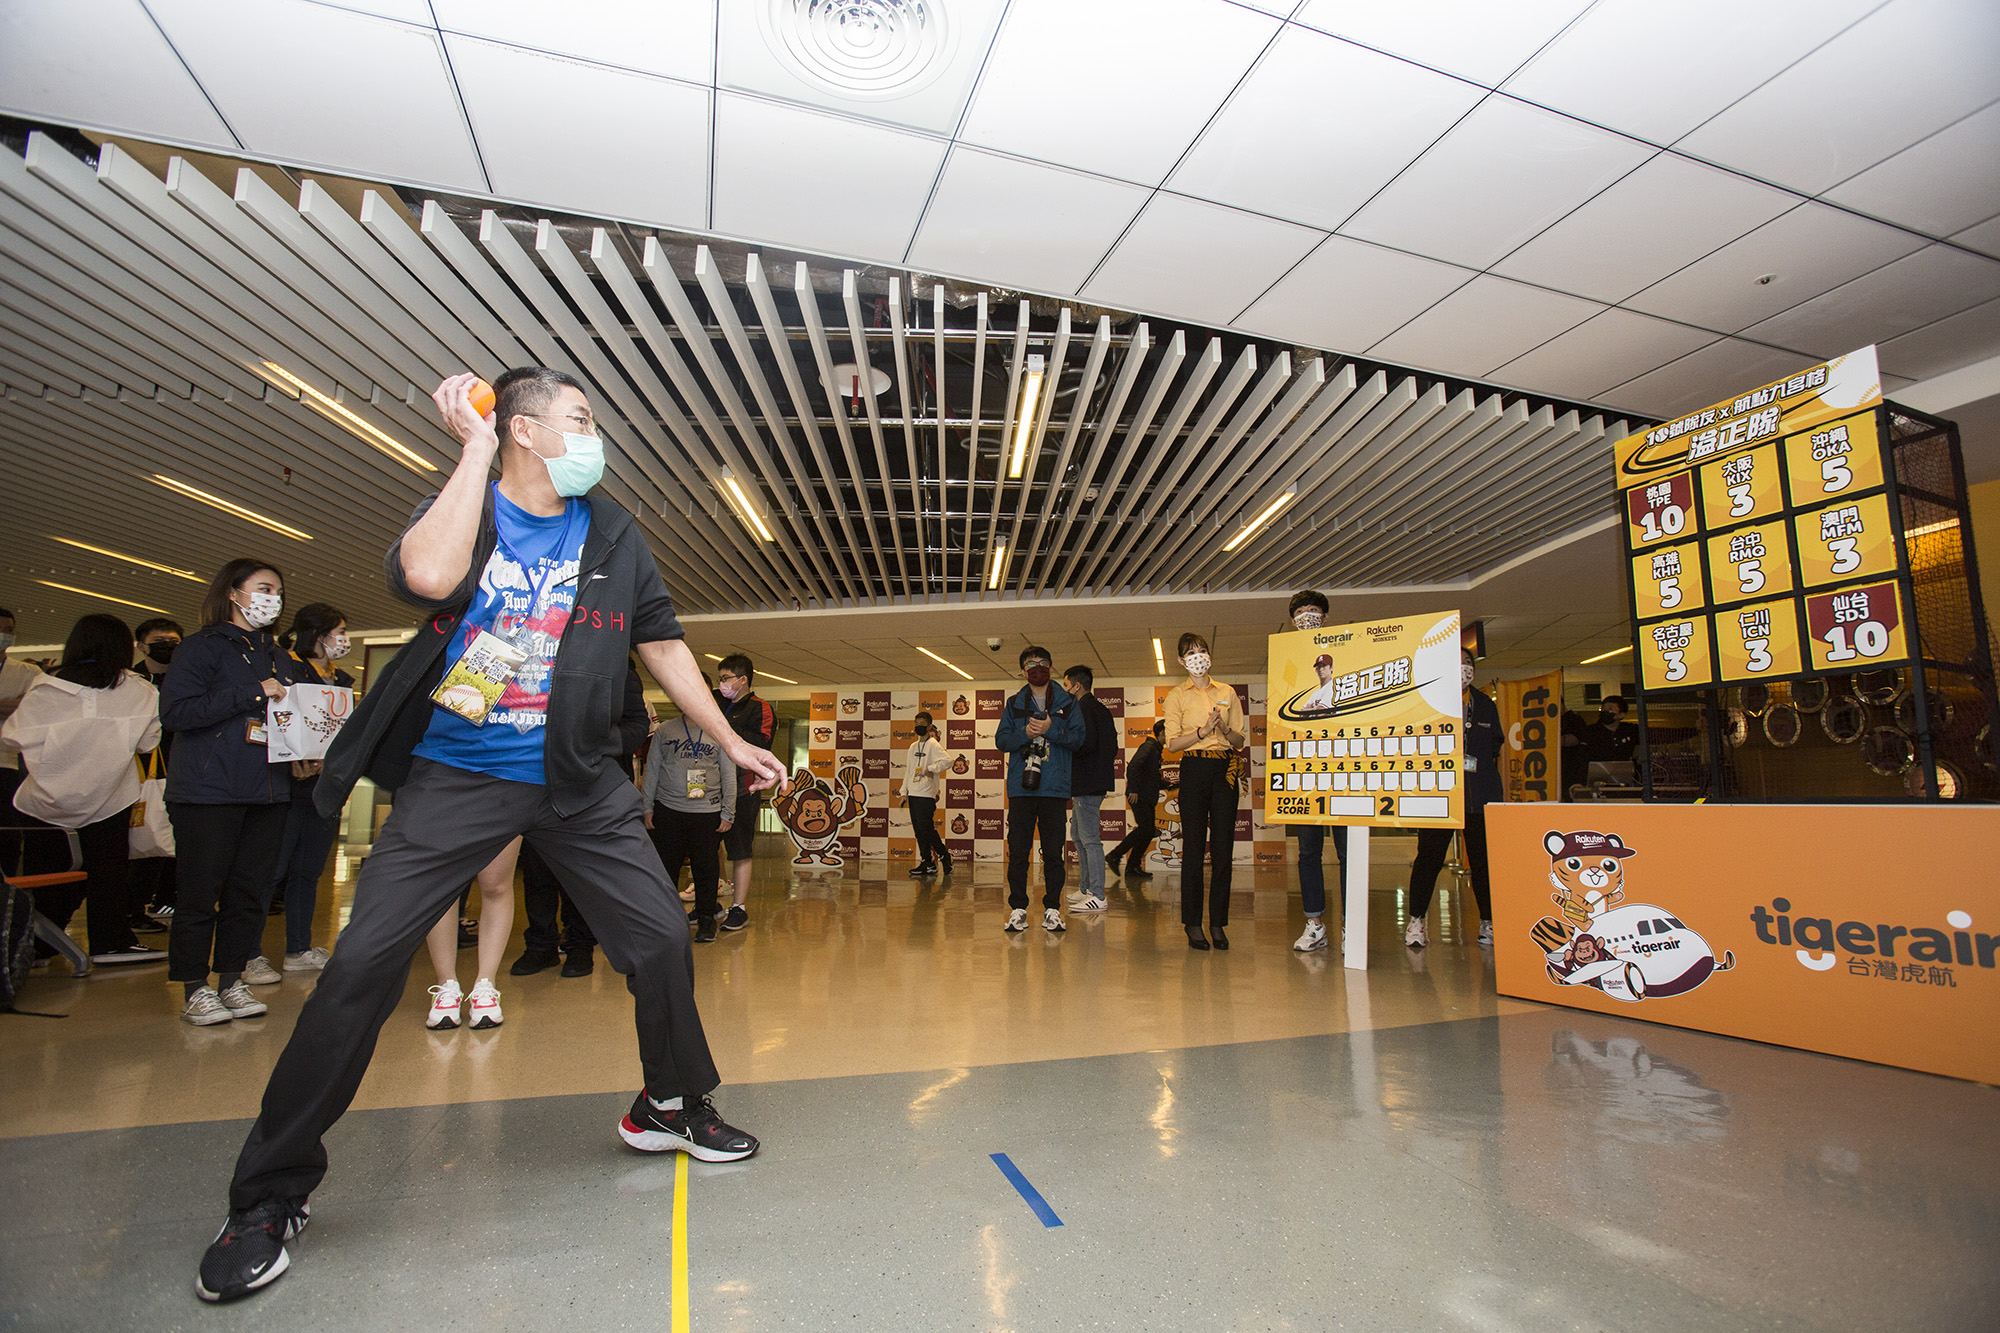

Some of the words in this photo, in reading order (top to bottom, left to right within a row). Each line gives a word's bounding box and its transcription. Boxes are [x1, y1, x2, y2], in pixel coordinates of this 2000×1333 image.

[1733, 367, 1826, 415] 航點九宮格
[1811, 426, 1848, 451] 沖繩
[1812, 441, 1852, 460] OKA
[1722, 455, 1753, 477] 大阪
[1822, 456, 1853, 492] 5
[1726, 471, 1752, 486] KIX
[1646, 481, 1672, 500] 桃園
[1648, 494, 1672, 510] TPE
[1728, 484, 1755, 517] 3
[1640, 505, 1685, 542] 10
[1821, 506, 1858, 531] 澳門
[1821, 519, 1863, 540] MFM
[1730, 532, 1761, 550] 台中
[1652, 551, 1680, 570] 高雄
[1729, 545, 1766, 563] RMQ
[1828, 537, 1861, 574] 3
[1653, 565, 1681, 580] KHH
[1738, 559, 1766, 593] 5
[1660, 577, 1683, 608] 5
[1833, 592, 1869, 612] 仙台
[1739, 609, 1770, 627] 仁川
[1835, 609, 1869, 624] SDJ
[1313, 629, 1354, 648] tigerair
[1366, 625, 1403, 637] Rakuten
[1372, 635, 1397, 643] MONKEYS
[1653, 622, 1694, 641] 名古屋
[1742, 624, 1771, 639] ICN
[1658, 636, 1690, 651] NGO
[1824, 621, 1889, 662] 10
[1745, 638, 1773, 672] 3
[1664, 650, 1687, 682] 3
[1292, 731, 1297, 739] 1
[1306, 730, 1313, 739] 2
[1321, 729, 1328, 738] 3
[1337, 729, 1345, 737] 4
[1354, 728, 1361, 737] 5
[1370, 727, 1378, 736] 6
[1388, 726, 1395, 735] 7
[1405, 725, 1413, 735] 8
[1423, 724, 1432, 734] 9
[1438, 723, 1454, 733] 10
[1272, 742, 1282, 758] 1
[1508, 685, 1559, 802] tiger
[1291, 763, 1296, 771] 1
[1305, 763, 1313, 771] 2
[1321, 762, 1328, 771] 3
[1337, 762, 1345, 771] 4
[1354, 762, 1361, 770] 5
[1370, 761, 1378, 770] 6
[1388, 761, 1395, 770] 7
[1405, 760, 1414, 770] 8
[1424, 760, 1432, 769] 9
[1439, 759, 1455, 769] 10
[1272, 774, 1283, 790] 2
[1276, 797, 1311, 806] TOTAL
[1315, 796, 1326, 815] 1
[1379, 796, 1395, 816] 2
[1276, 806, 1310, 815] SCORE
[1575, 835, 1606, 844] Rakuten
[1631, 936, 1681, 958] tigerair
[1846, 956, 1957, 988] 台灣虎航
